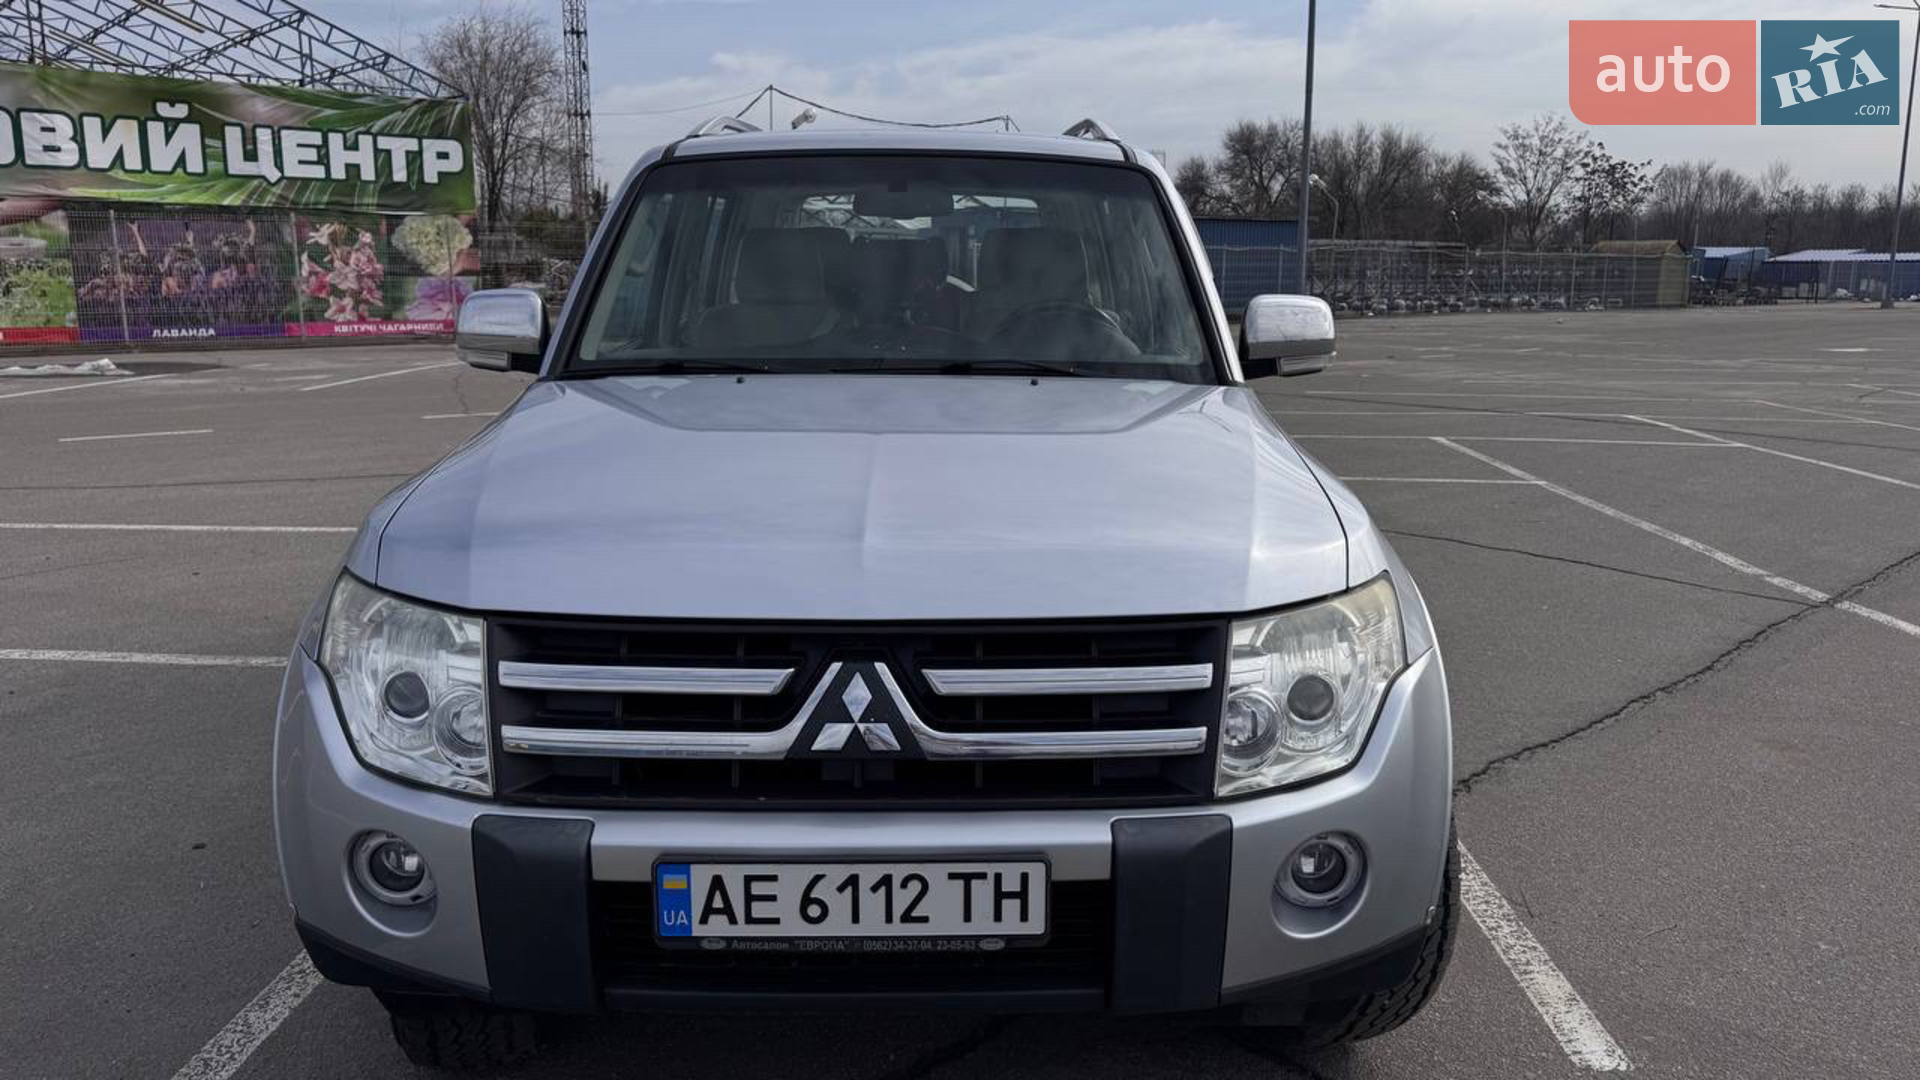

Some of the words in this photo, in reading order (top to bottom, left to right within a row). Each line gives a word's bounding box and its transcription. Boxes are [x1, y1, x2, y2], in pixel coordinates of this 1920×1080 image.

[224, 125, 464, 184] ЦЕНТР
[153, 327, 216, 338] ЛАВАНДА
[699, 873, 781, 925] AE
[799, 873, 930, 925] 6112
[948, 872, 1029, 923] TH
[664, 911, 688, 926] UA
[732, 940, 789, 950] Автосалон
